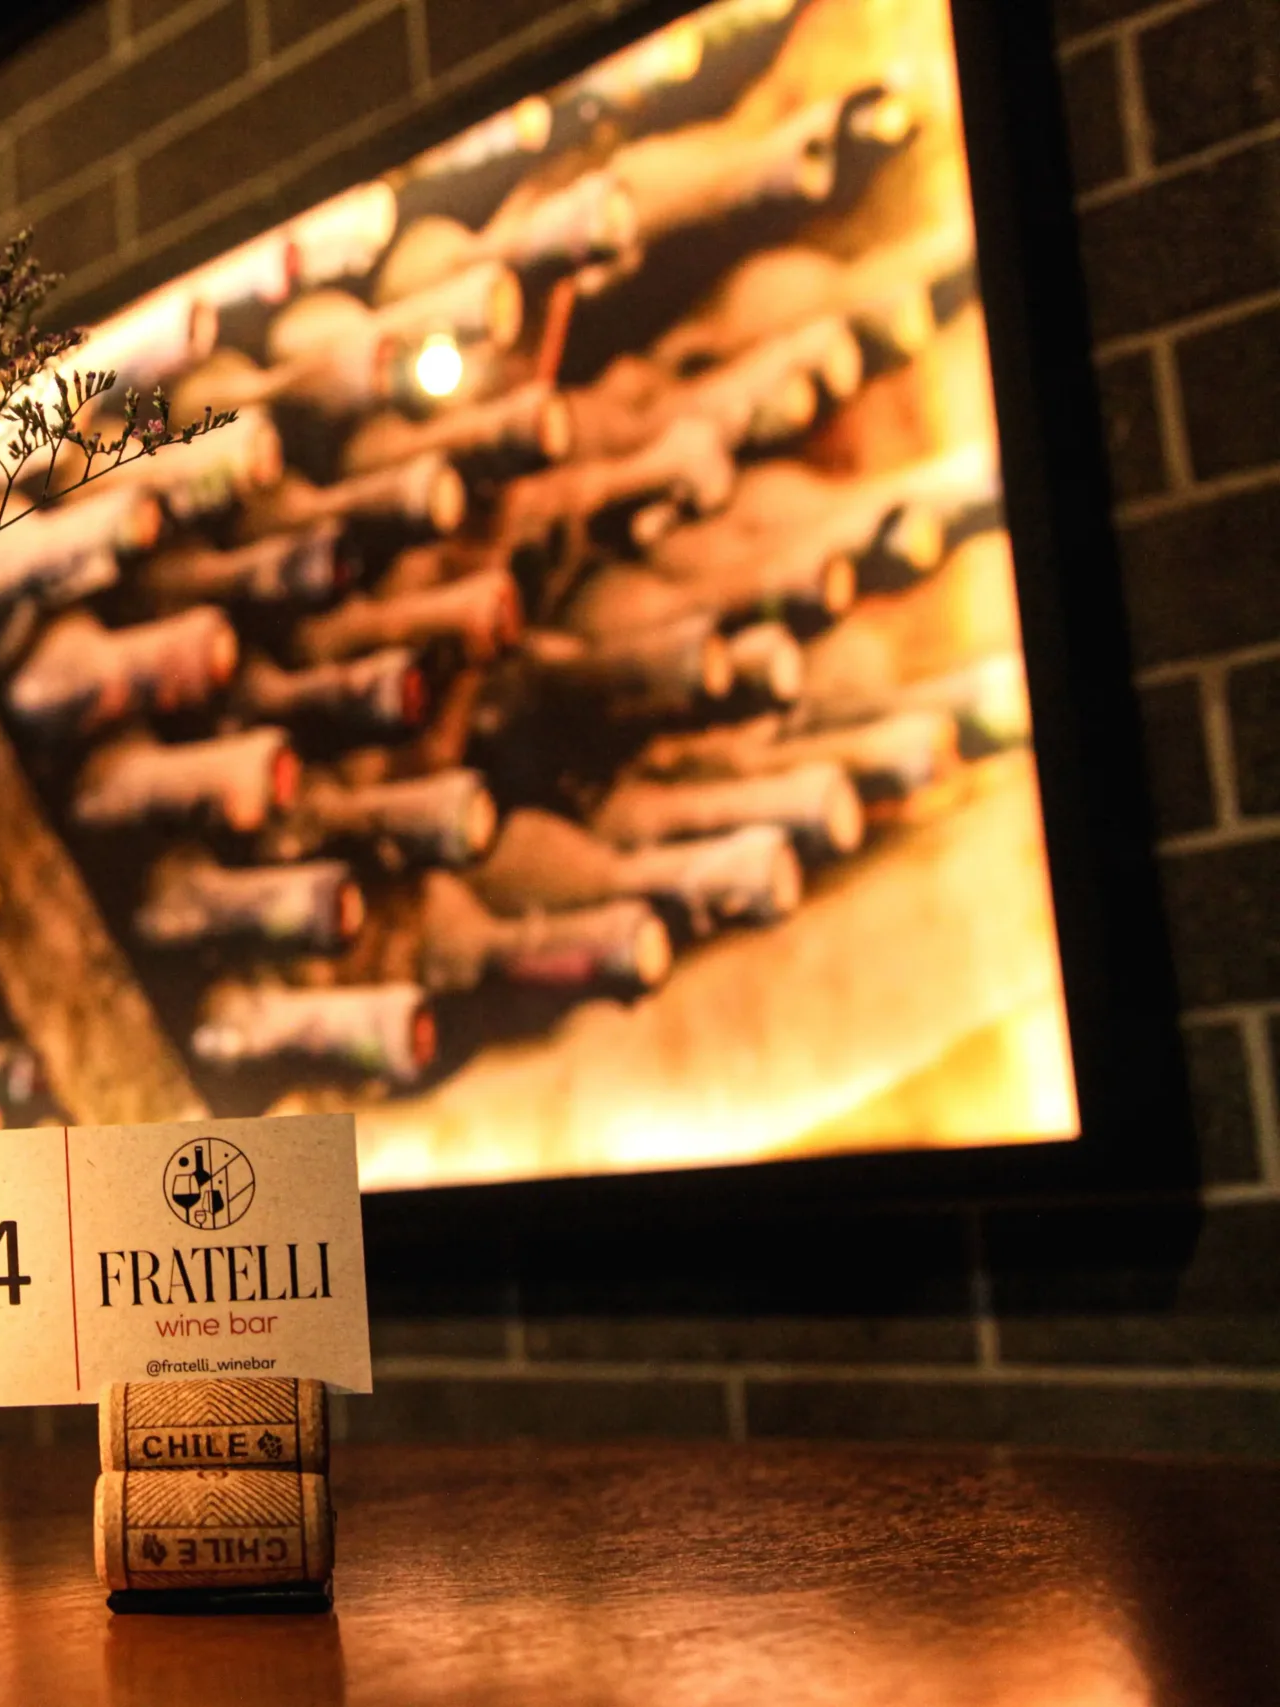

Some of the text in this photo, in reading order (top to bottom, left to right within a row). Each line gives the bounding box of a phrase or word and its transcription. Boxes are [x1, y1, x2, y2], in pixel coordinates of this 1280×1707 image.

[98, 1242, 333, 1307] FRATELLI
[155, 1311, 278, 1338] wine bar
[146, 1357, 277, 1377] @fratelli_winebar
[141, 1432, 249, 1460] CHILE
[176, 1536, 288, 1565] CHILE
